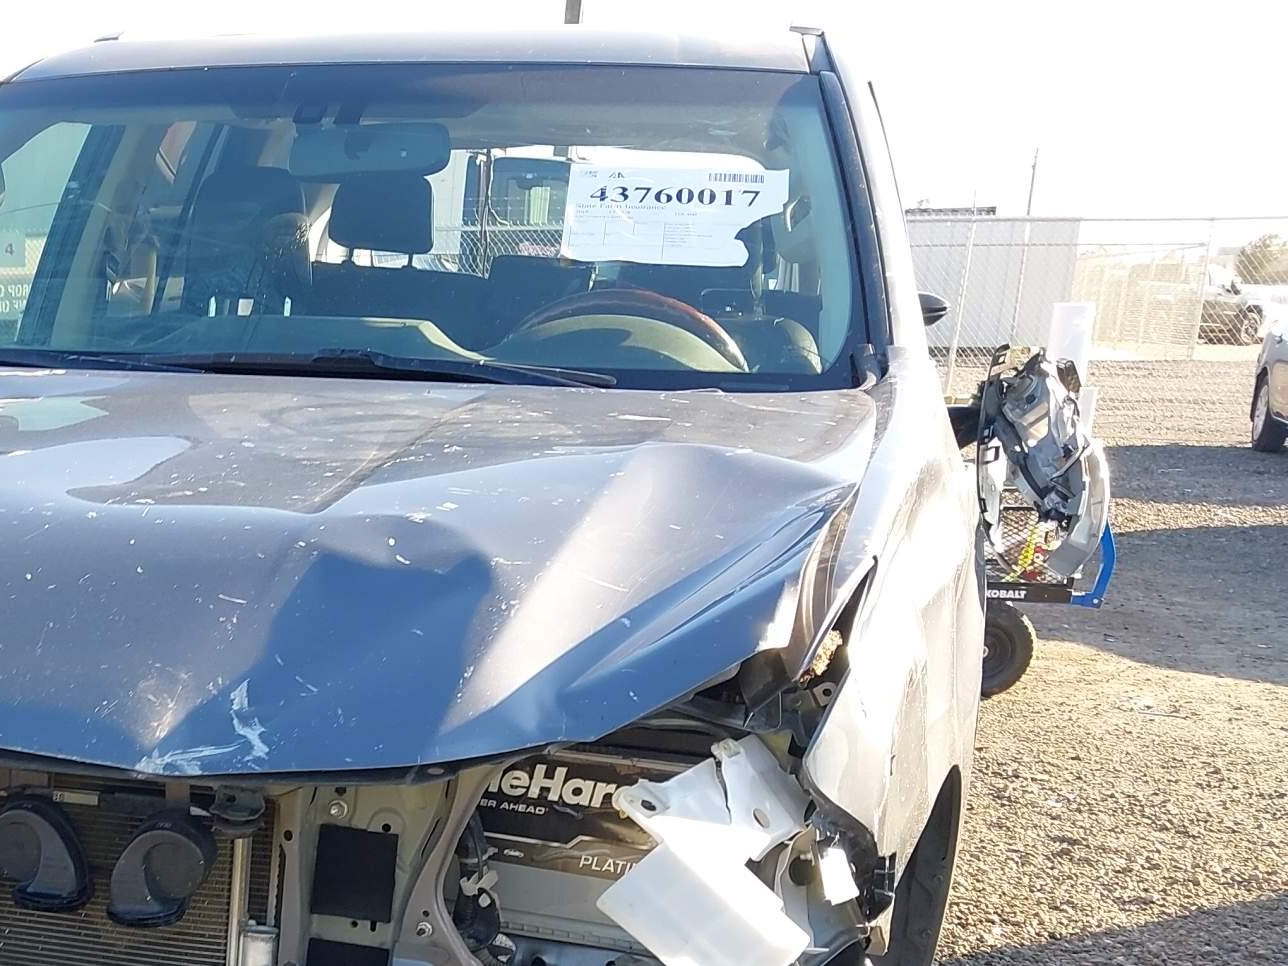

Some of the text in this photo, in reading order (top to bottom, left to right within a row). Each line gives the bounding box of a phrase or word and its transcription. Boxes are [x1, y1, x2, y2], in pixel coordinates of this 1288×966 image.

[590, 185, 761, 207] 43760017
[4, 243, 15, 256] 4
[500, 802, 546, 815] AHEAD
